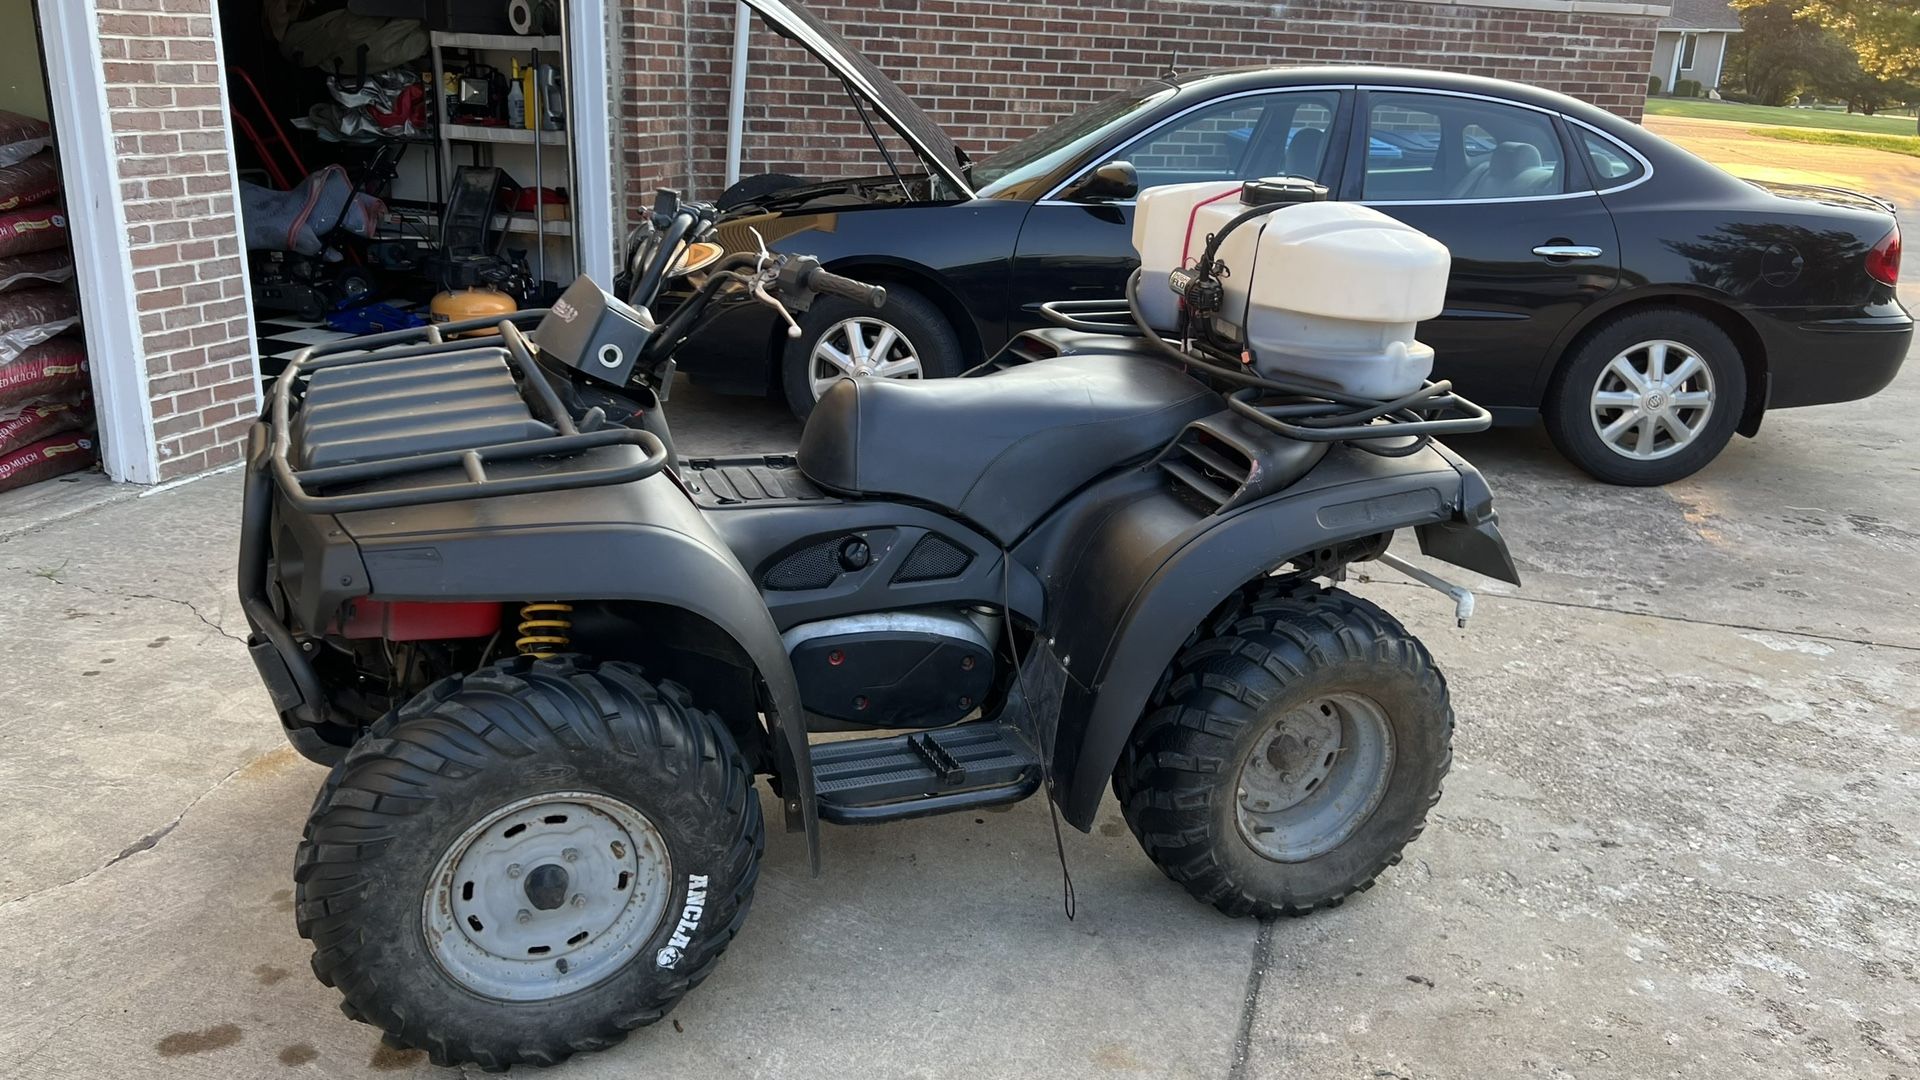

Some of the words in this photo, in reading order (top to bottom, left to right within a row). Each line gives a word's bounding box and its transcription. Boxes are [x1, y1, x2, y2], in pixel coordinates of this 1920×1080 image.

[10, 371, 37, 385] MULCH
[8, 415, 33, 431] MULCH
[10, 453, 38, 469] MULCH
[668, 874, 708, 949] ANCLA
